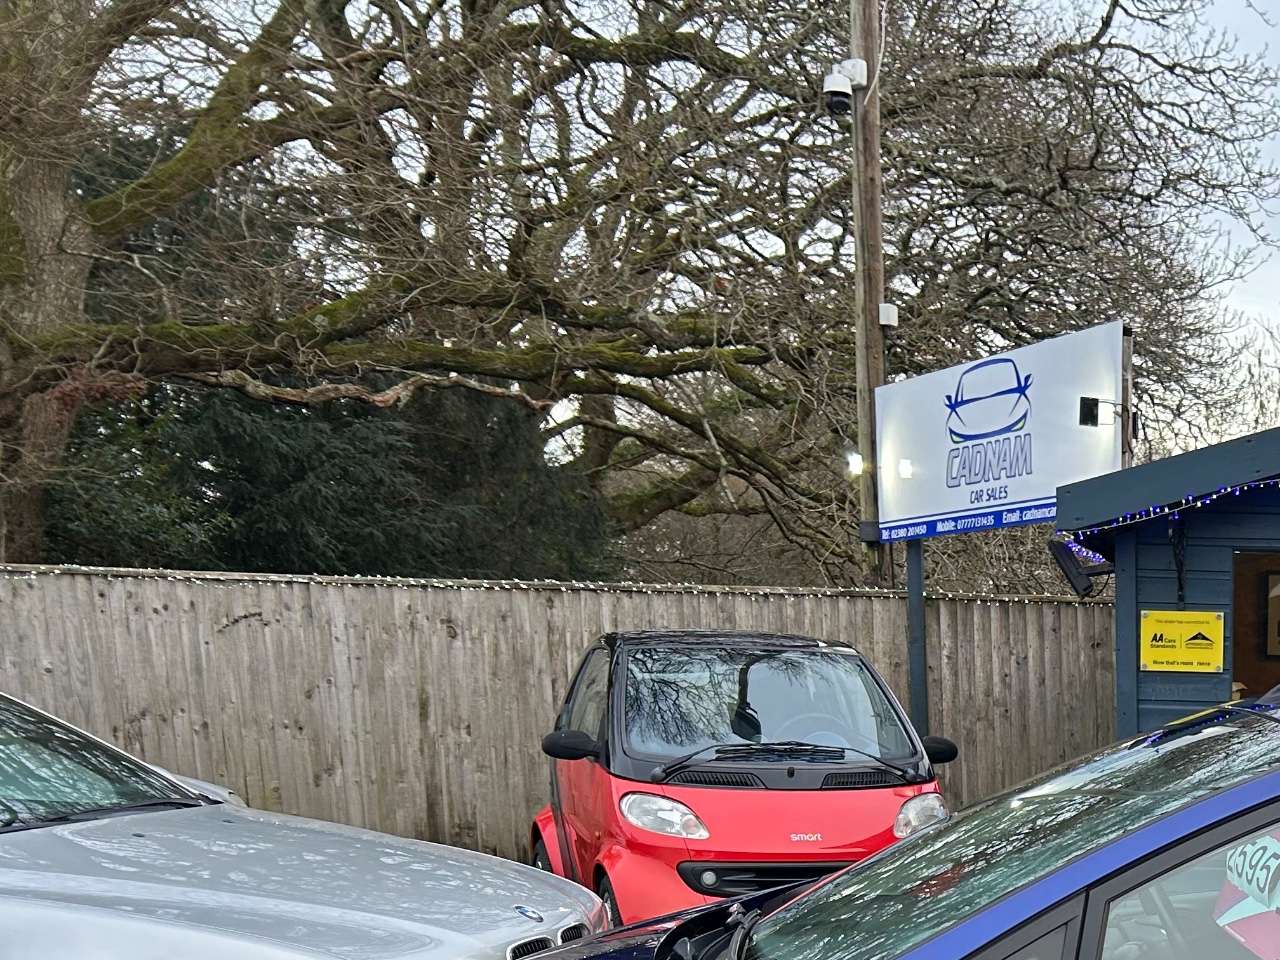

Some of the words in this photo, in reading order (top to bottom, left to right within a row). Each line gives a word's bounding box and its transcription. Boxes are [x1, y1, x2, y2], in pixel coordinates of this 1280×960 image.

[946, 432, 1033, 488] CADNAM
[969, 489, 984, 504] CAR
[986, 485, 1009, 502] SALES
[1002, 509, 1022, 524] Email:
[1150, 632, 1164, 644] AA
[789, 832, 823, 841] smart
